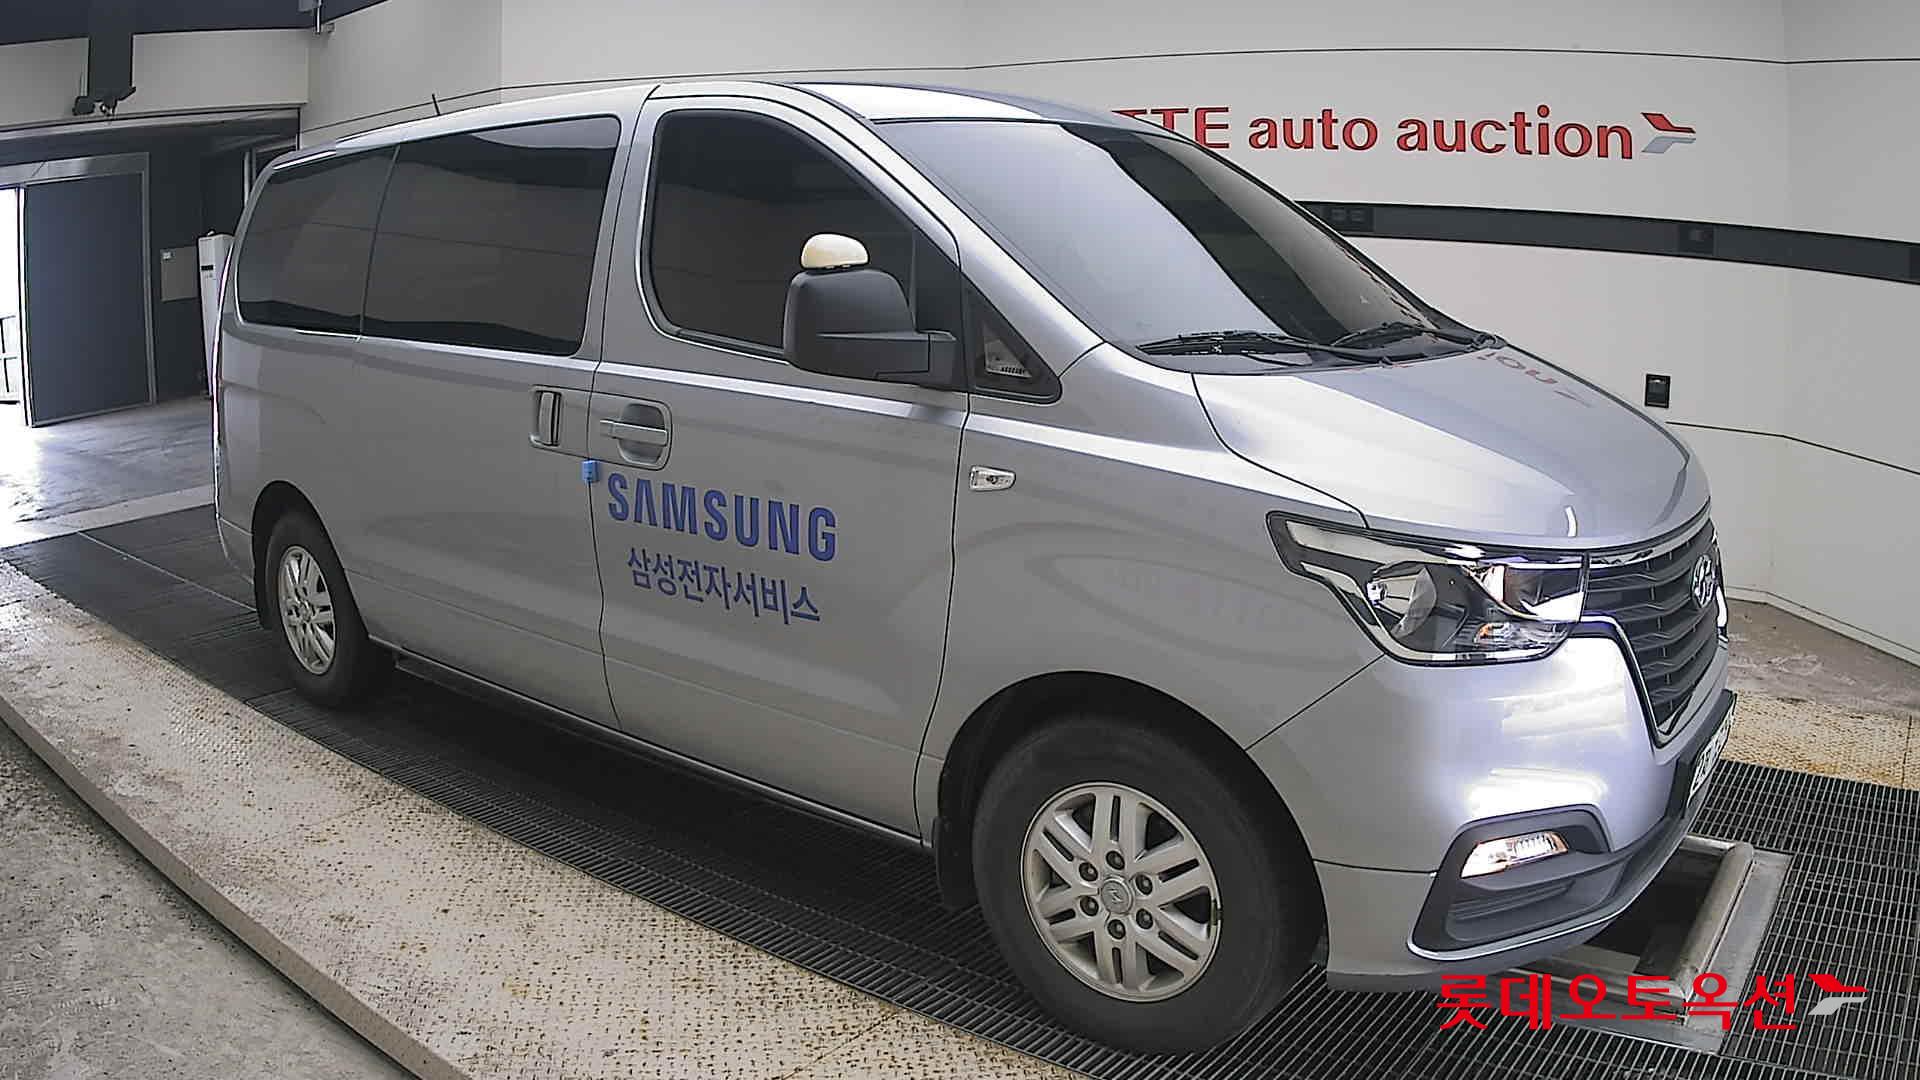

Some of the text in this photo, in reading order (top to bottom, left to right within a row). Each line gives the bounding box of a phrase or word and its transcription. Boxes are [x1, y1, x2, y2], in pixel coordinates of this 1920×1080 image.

[1111, 104, 1634, 160] TE auto auction
[607, 472, 837, 562] SAMSUNG
[627, 547, 821, 625] 삼성전자서비스
